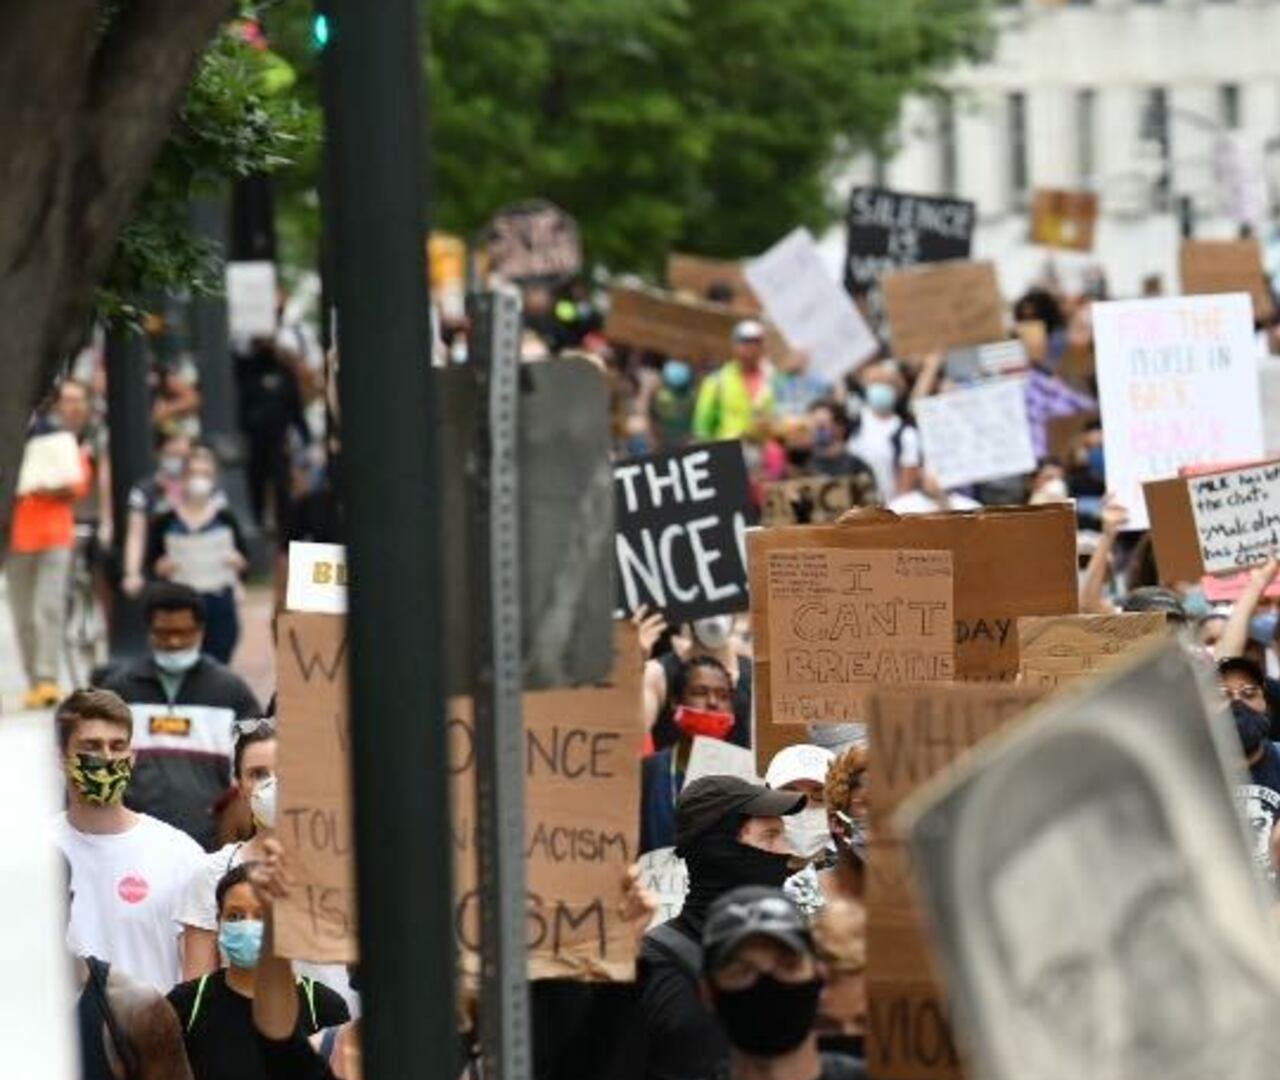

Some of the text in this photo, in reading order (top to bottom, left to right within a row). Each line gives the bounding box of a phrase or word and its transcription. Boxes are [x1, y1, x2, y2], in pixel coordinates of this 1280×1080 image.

[851, 187, 970, 241] SILENCE
[615, 451, 717, 511] THE
[792, 597, 947, 643] CAN'T
